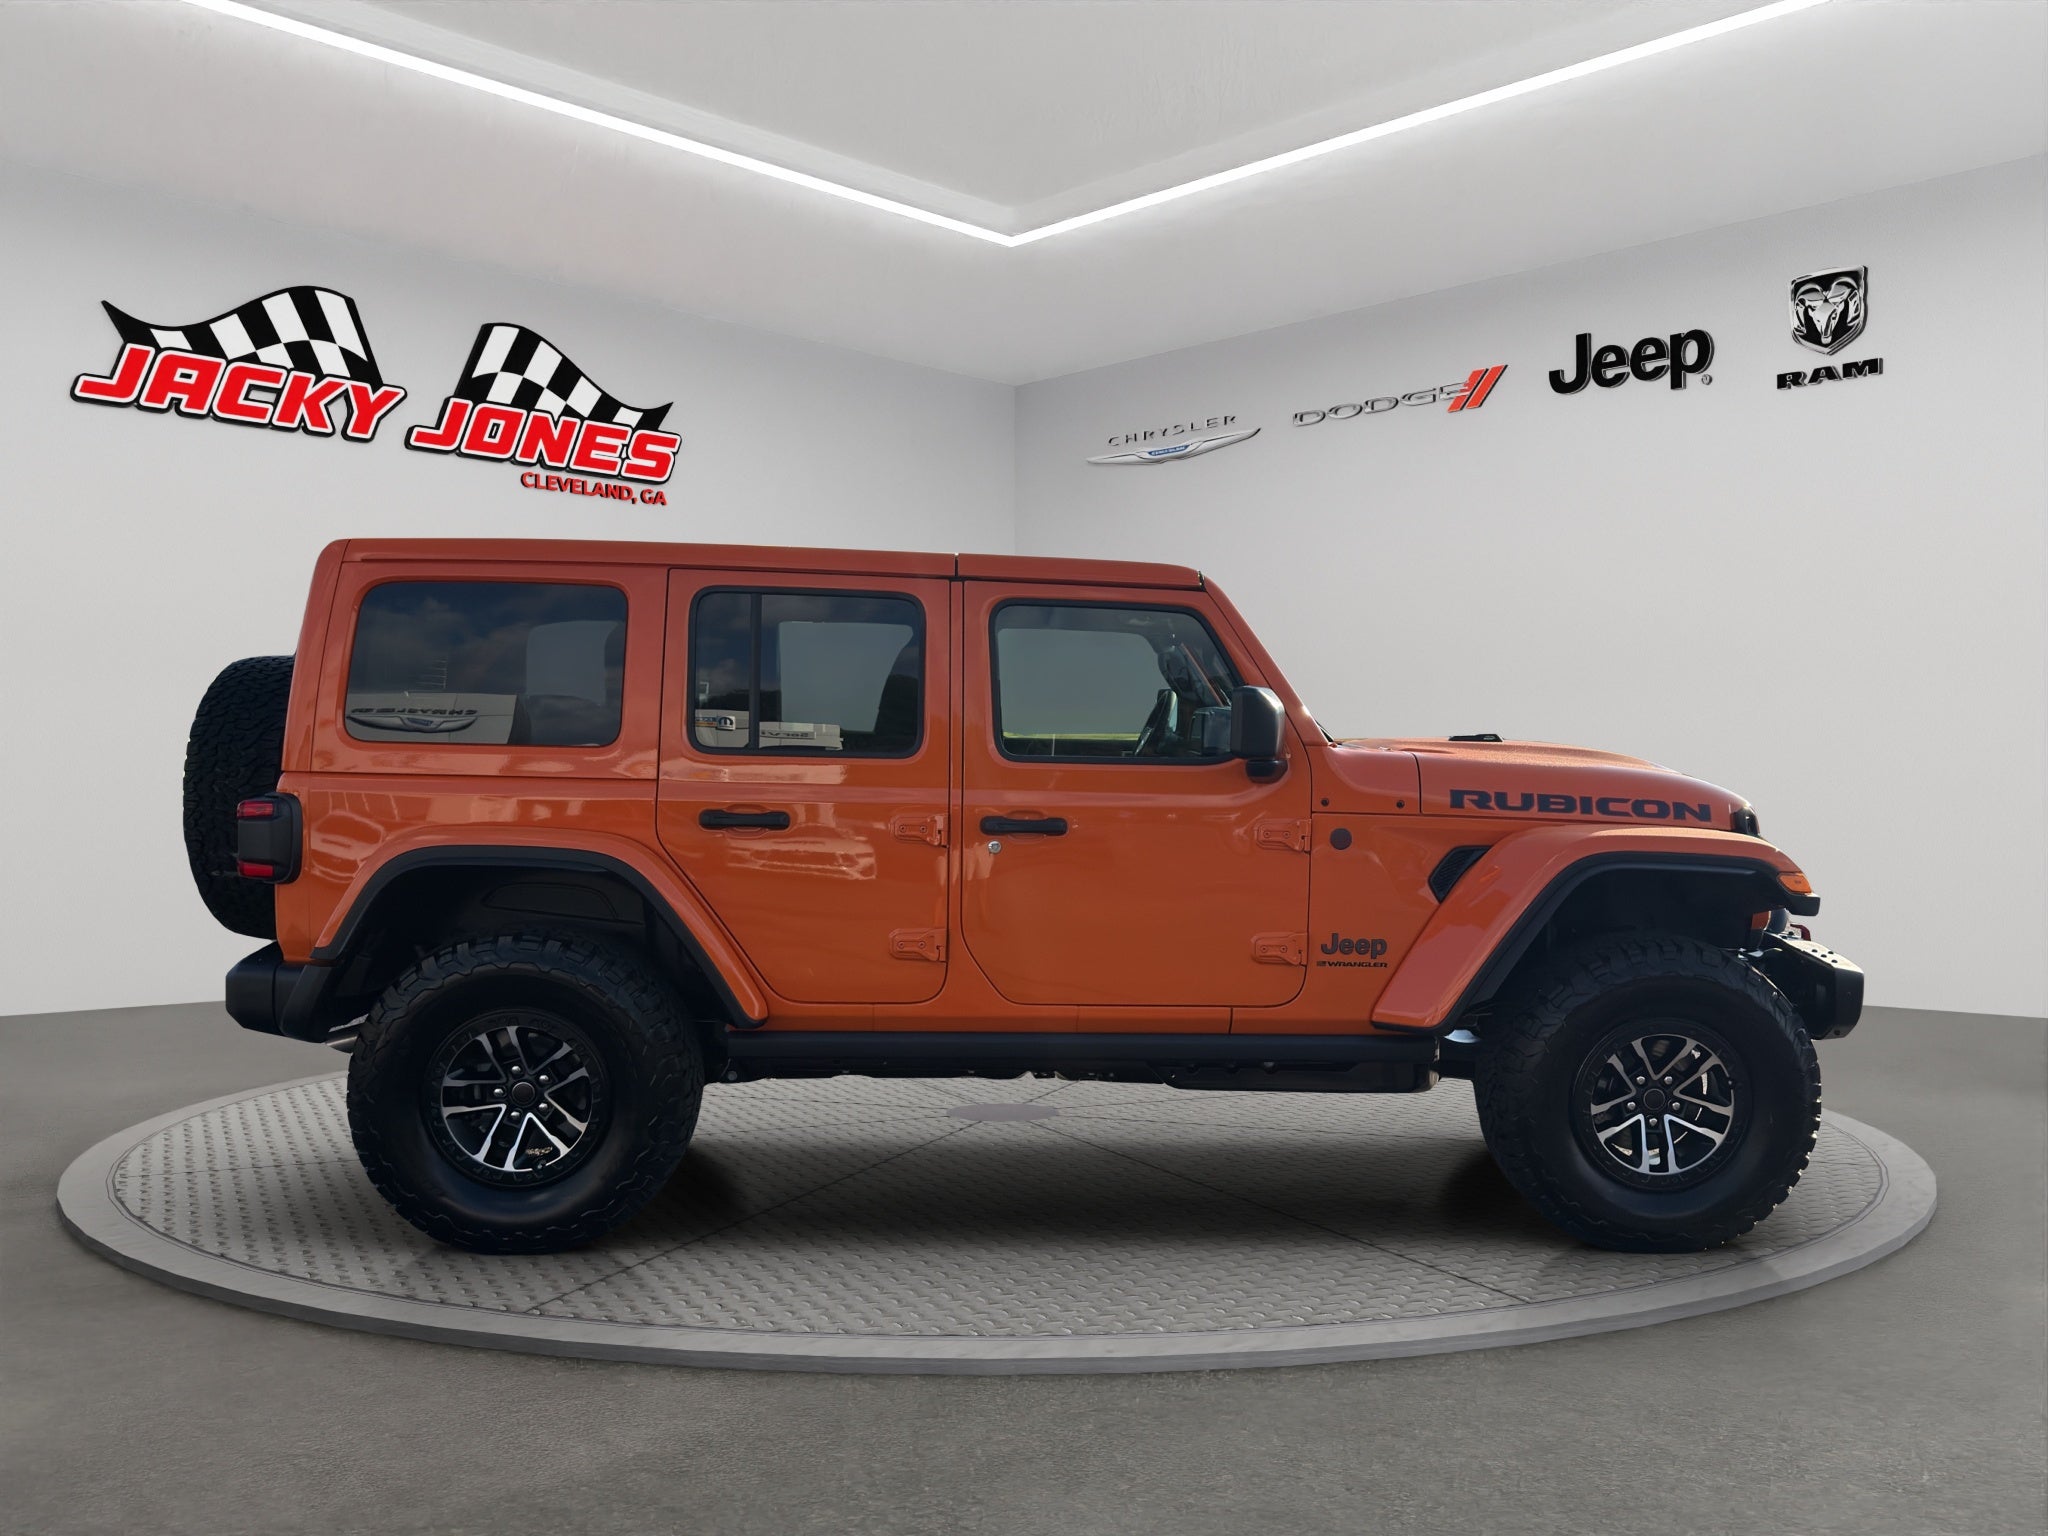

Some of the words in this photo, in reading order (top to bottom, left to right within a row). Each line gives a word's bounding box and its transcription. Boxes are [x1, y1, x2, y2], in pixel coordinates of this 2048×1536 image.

[1549, 329, 1714, 394] Jeep
[1776, 357, 1883, 389] RAM
[72, 340, 404, 440] JACKY
[1293, 380, 1470, 427] DODGE
[409, 397, 680, 482] JONES
[1108, 415, 1236, 447] CHRYSLER
[520, 471, 638, 504] CLEVELAND,
[640, 488, 667, 506] GA
[1449, 789, 1712, 822] RUBICON
[1321, 932, 1387, 960] Jeep
[1327, 960, 1388, 968] WRANGLER
